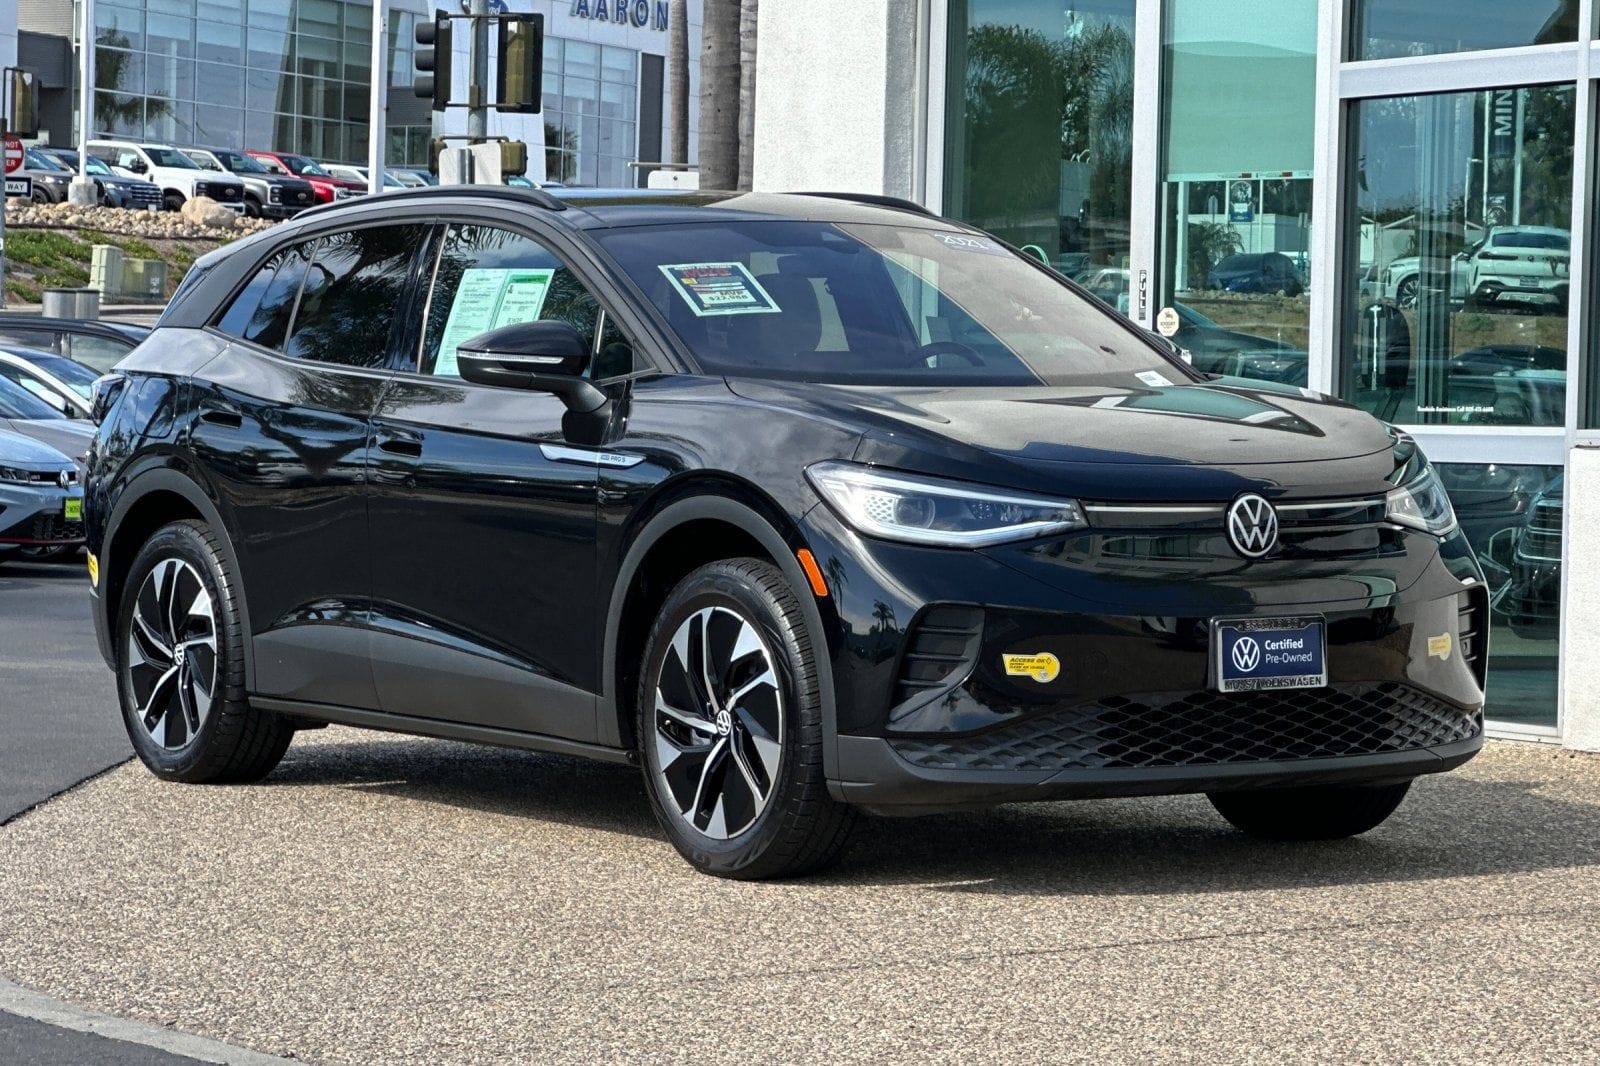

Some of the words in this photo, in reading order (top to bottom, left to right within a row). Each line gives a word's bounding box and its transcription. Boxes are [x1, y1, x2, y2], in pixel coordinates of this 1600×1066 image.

[573, 0, 669, 31] AARON
[5, 141, 19, 149] NOT
[7, 183, 25, 191] WAY
[1264, 638, 1304, 650] Certified
[1265, 651, 1313, 664] Pre-Owned
[1260, 676, 1322, 688] VOLKSWAGEN
